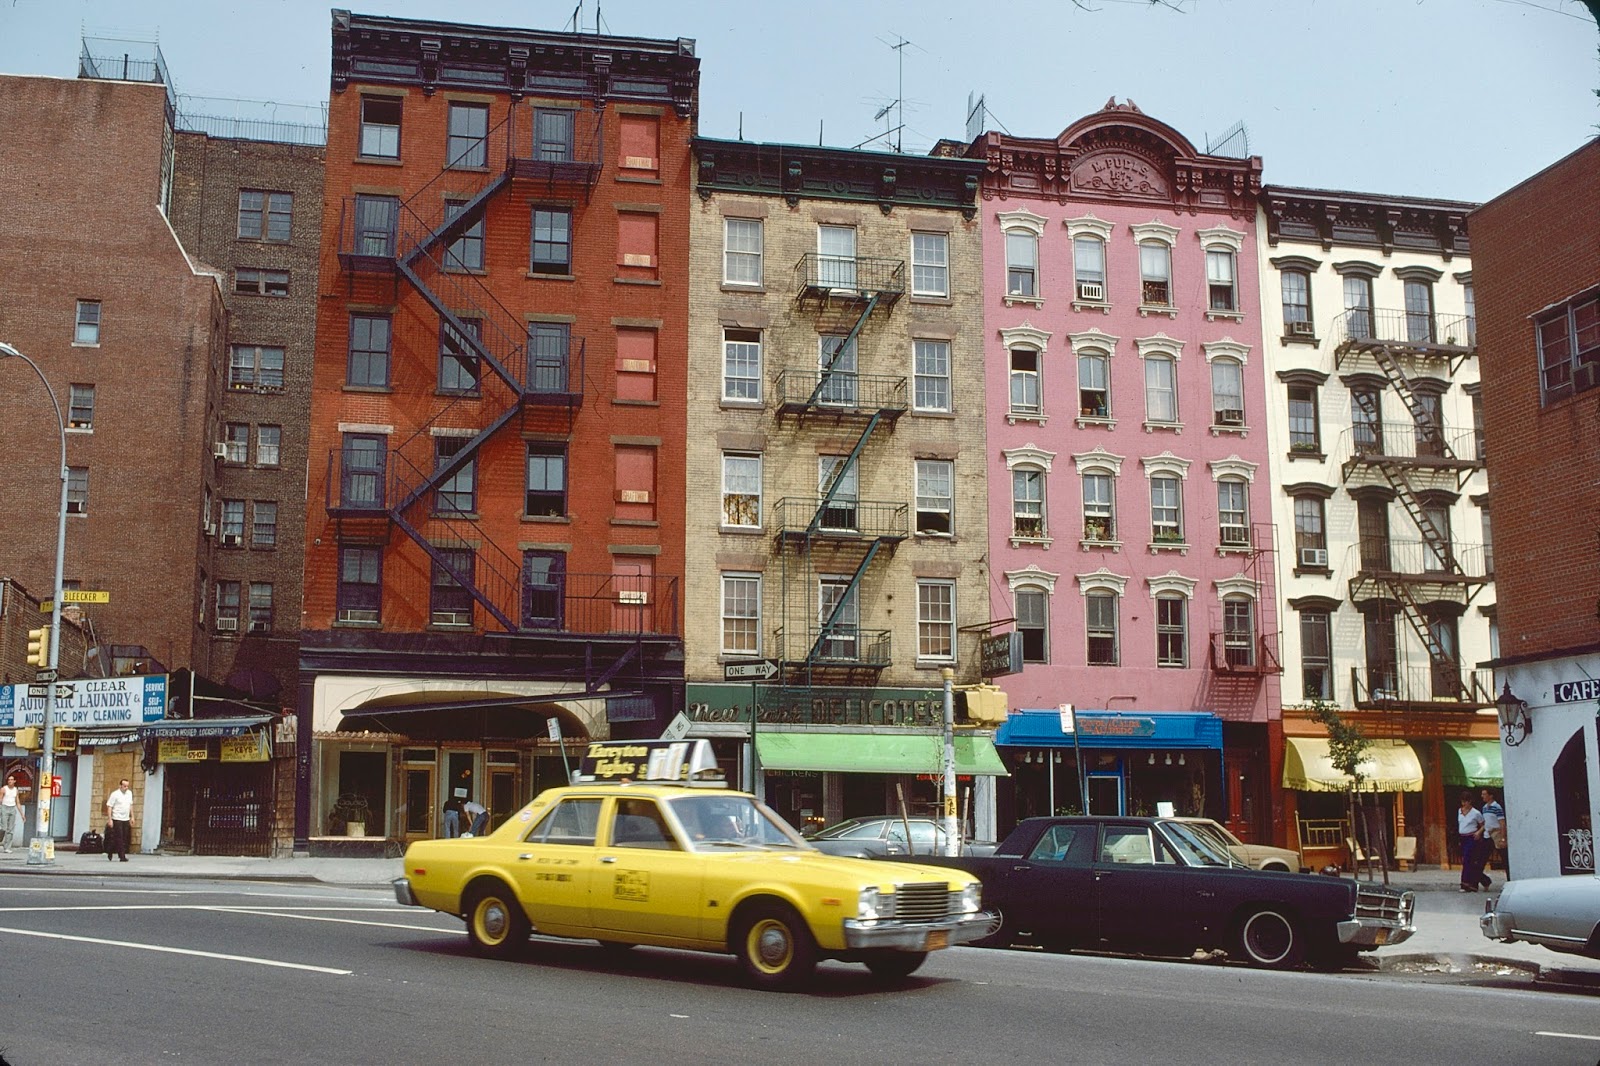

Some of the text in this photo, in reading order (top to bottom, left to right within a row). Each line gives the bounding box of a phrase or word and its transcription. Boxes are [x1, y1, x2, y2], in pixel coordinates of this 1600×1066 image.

[64, 592, 97, 601] BLEECKER
[729, 665, 772, 676] ONE WAY
[31, 687, 46, 695] ONE
[56, 687, 67, 695] AY
[86, 680, 126, 692] CLEAR
[145, 682, 165, 692] SERVICE
[19, 696, 75, 711] AUTOATIC
[79, 691, 132, 708] LAUNDRY
[148, 697, 162, 706] SELF-
[144, 706, 163, 715] SERVICE
[812, 698, 957, 726] DELICATES
[25, 709, 132, 724] AUTOTIC DRY CLEANING
